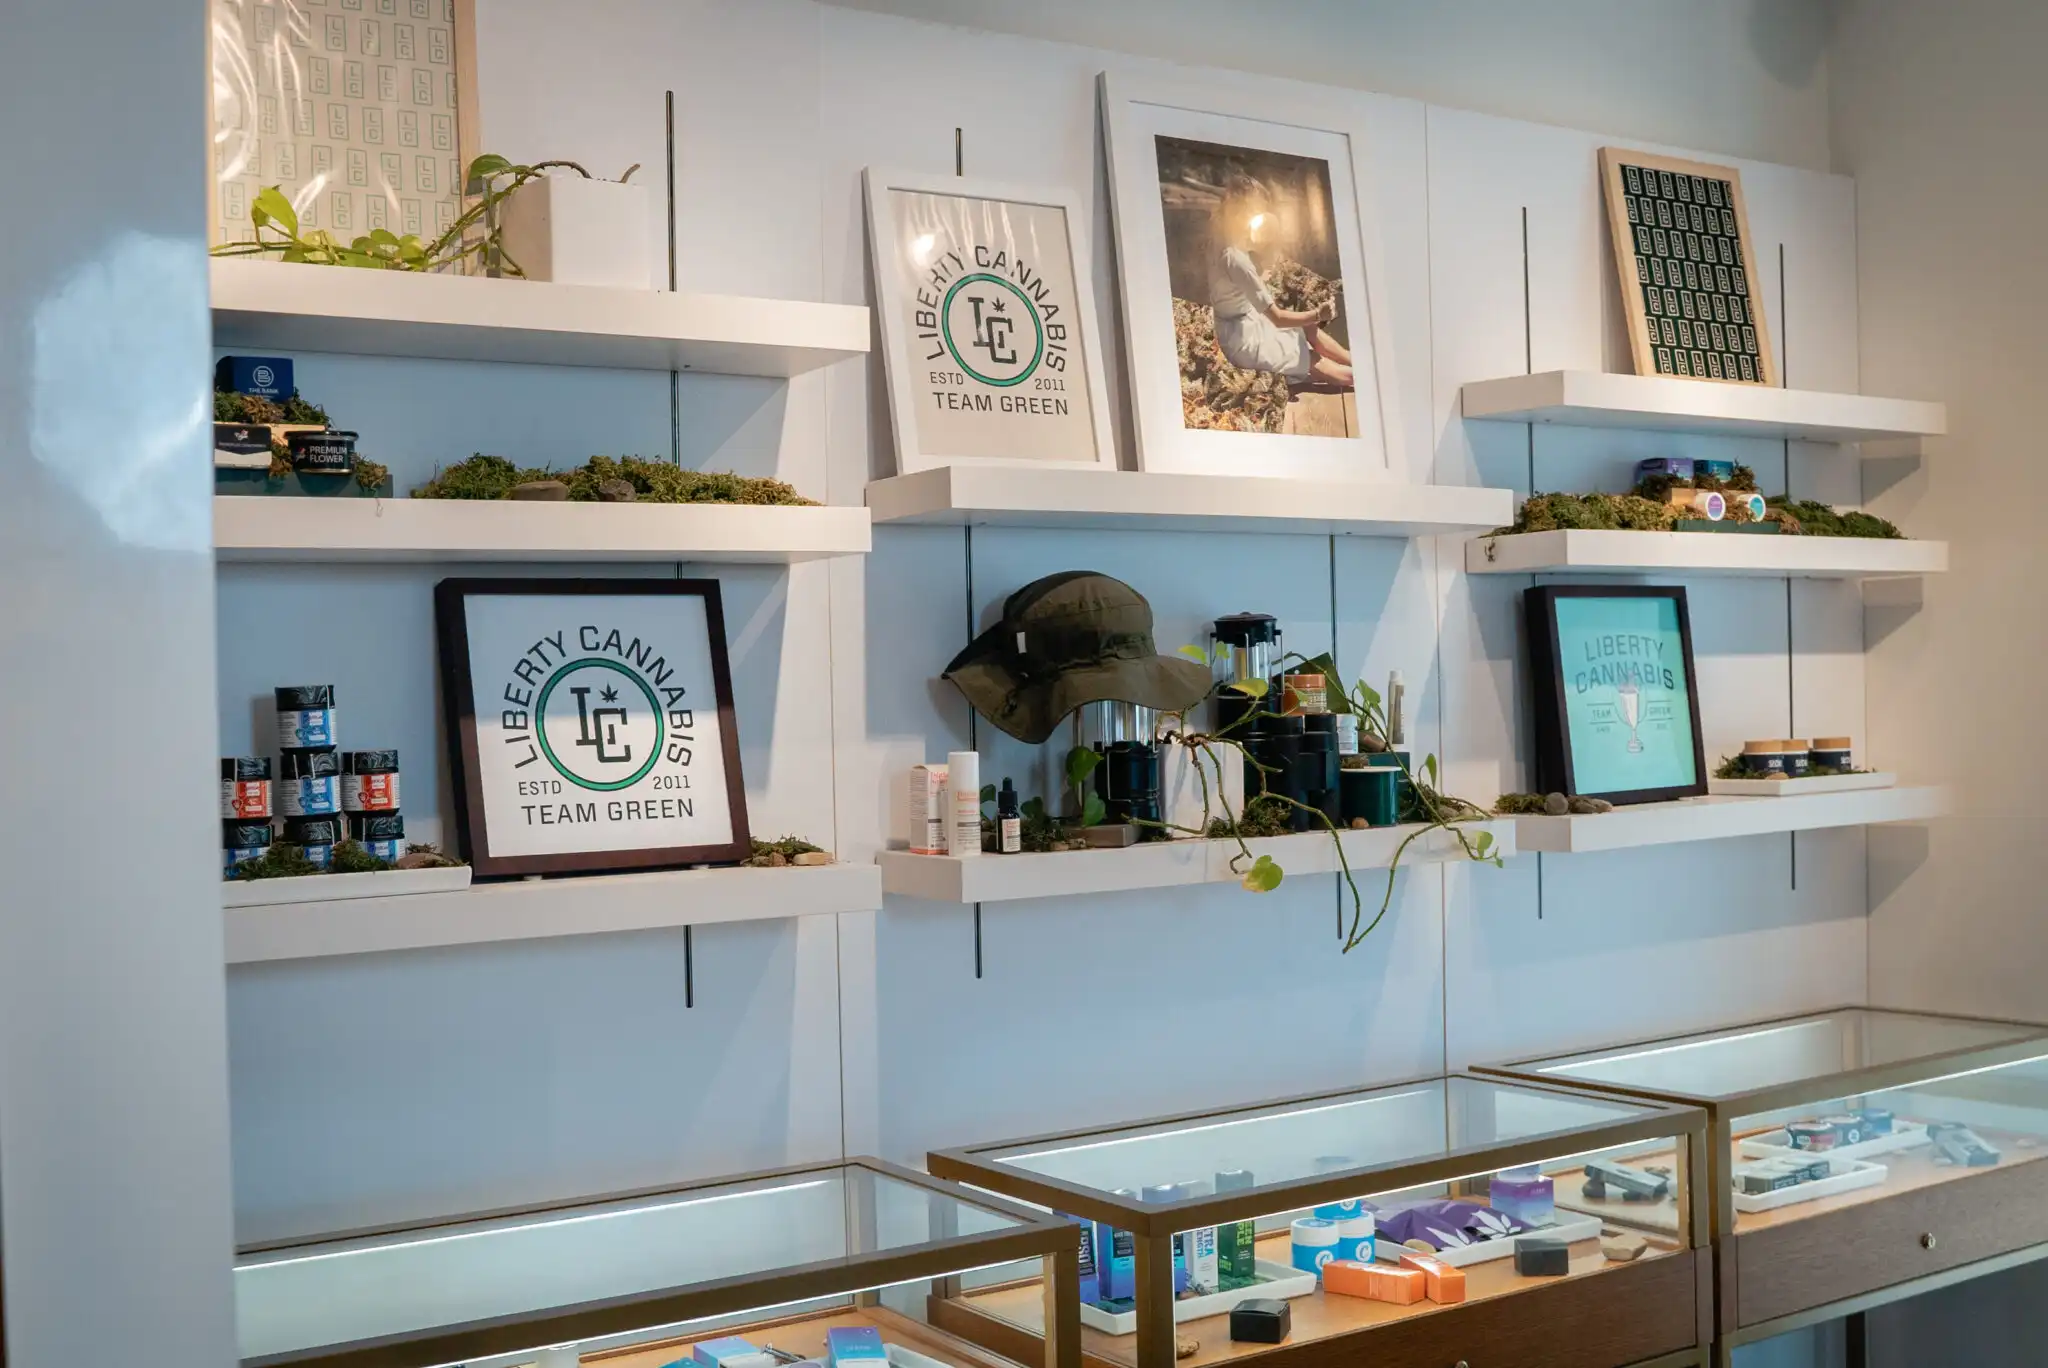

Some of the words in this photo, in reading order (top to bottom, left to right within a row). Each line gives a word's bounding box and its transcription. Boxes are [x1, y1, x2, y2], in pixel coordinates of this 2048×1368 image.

[975, 245, 1067, 372] CANNABIS
[930, 371, 964, 385] ESTD
[1035, 378, 1066, 391] 2011
[932, 392, 992, 412] TEAM
[1000, 396, 1068, 415] GREEN
[309, 445, 347, 454] PREMIUM
[309, 454, 344, 463] FLOWER
[1584, 635, 1664, 663] LIBERTY
[1575, 661, 1674, 694] CANNABIS
[502, 631, 566, 769] LIBERTY
[579, 625, 694, 767] CANNABIS
[518, 780, 562, 796] ESTD
[653, 775, 691, 790] 2011
[521, 803, 597, 825] TEAM
[607, 798, 694, 821] GREEN
